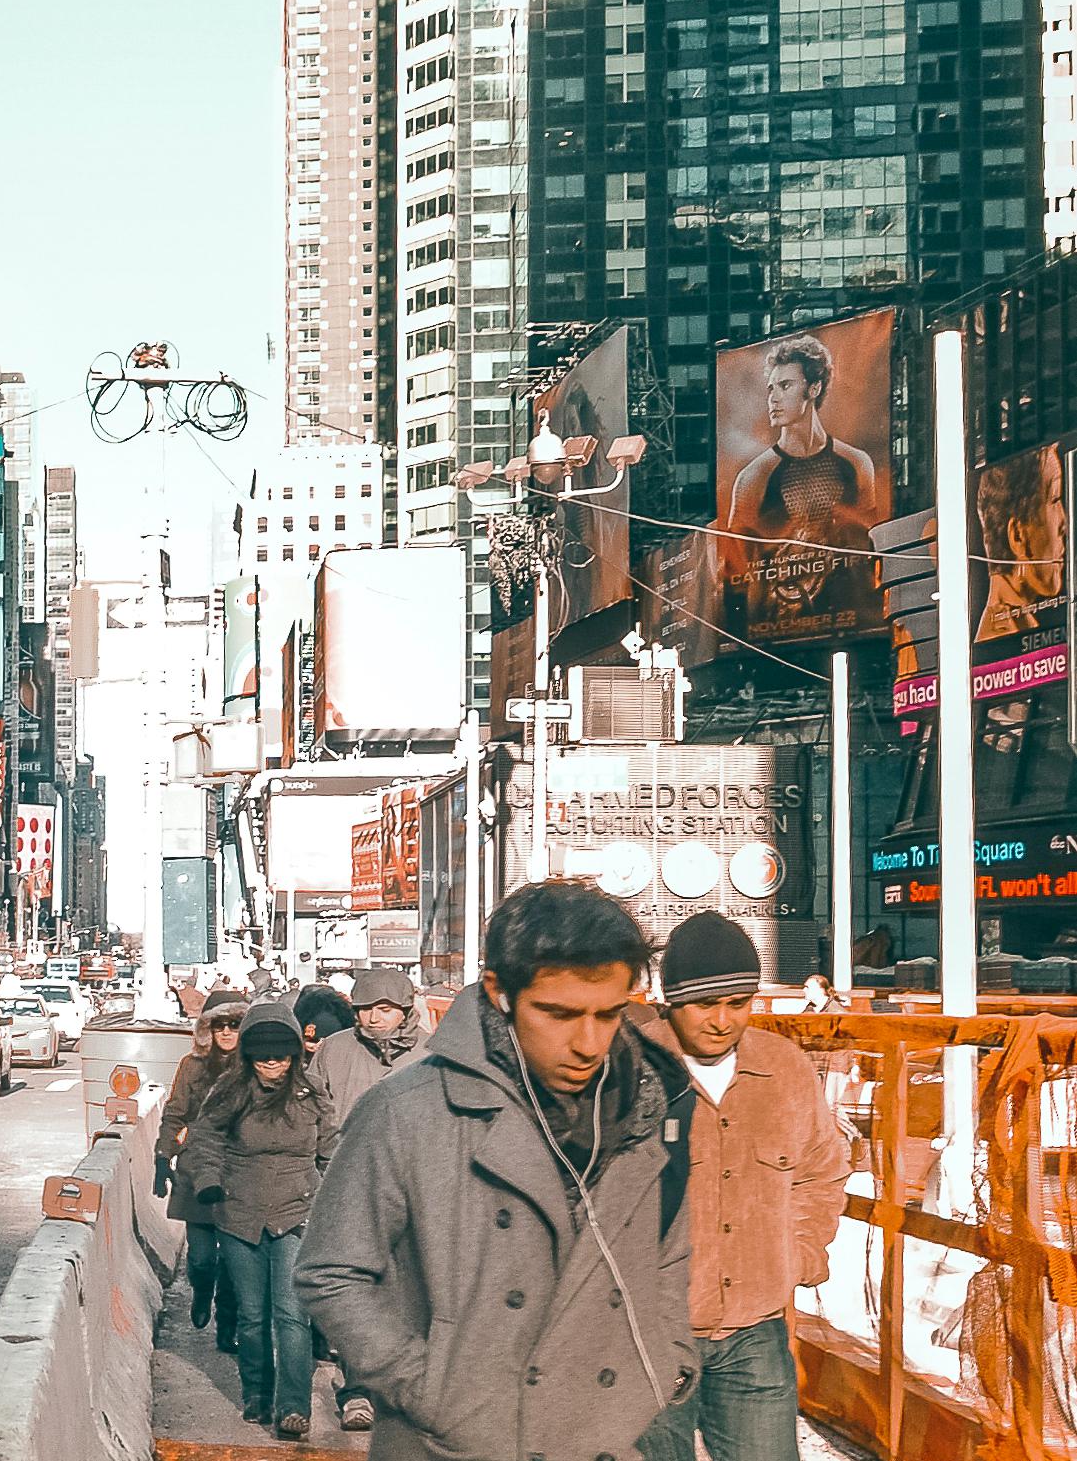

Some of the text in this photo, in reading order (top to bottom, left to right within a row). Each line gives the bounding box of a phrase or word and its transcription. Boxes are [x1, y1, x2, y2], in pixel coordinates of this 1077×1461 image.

[730, 560, 825, 586] CATCHING
[746, 558, 765, 568] THE
[769, 552, 815, 566] HUNGER
[748, 613, 833, 634] NOVEMBER
[1021, 627, 1068, 653] SIEMEN
[909, 678, 937, 705] had
[973, 667, 1018, 699] power
[1019, 661, 1033, 683] to
[1034, 654, 1066, 679] save
[681, 783, 803, 810] FORCES
[681, 814, 787, 835] STATION
[872, 850, 908, 871] Welcome
[910, 845, 924, 867] To
[974, 840, 1025, 866] Square
[1000, 872, 1052, 898] won't
[1054, 871, 1077, 896] all
